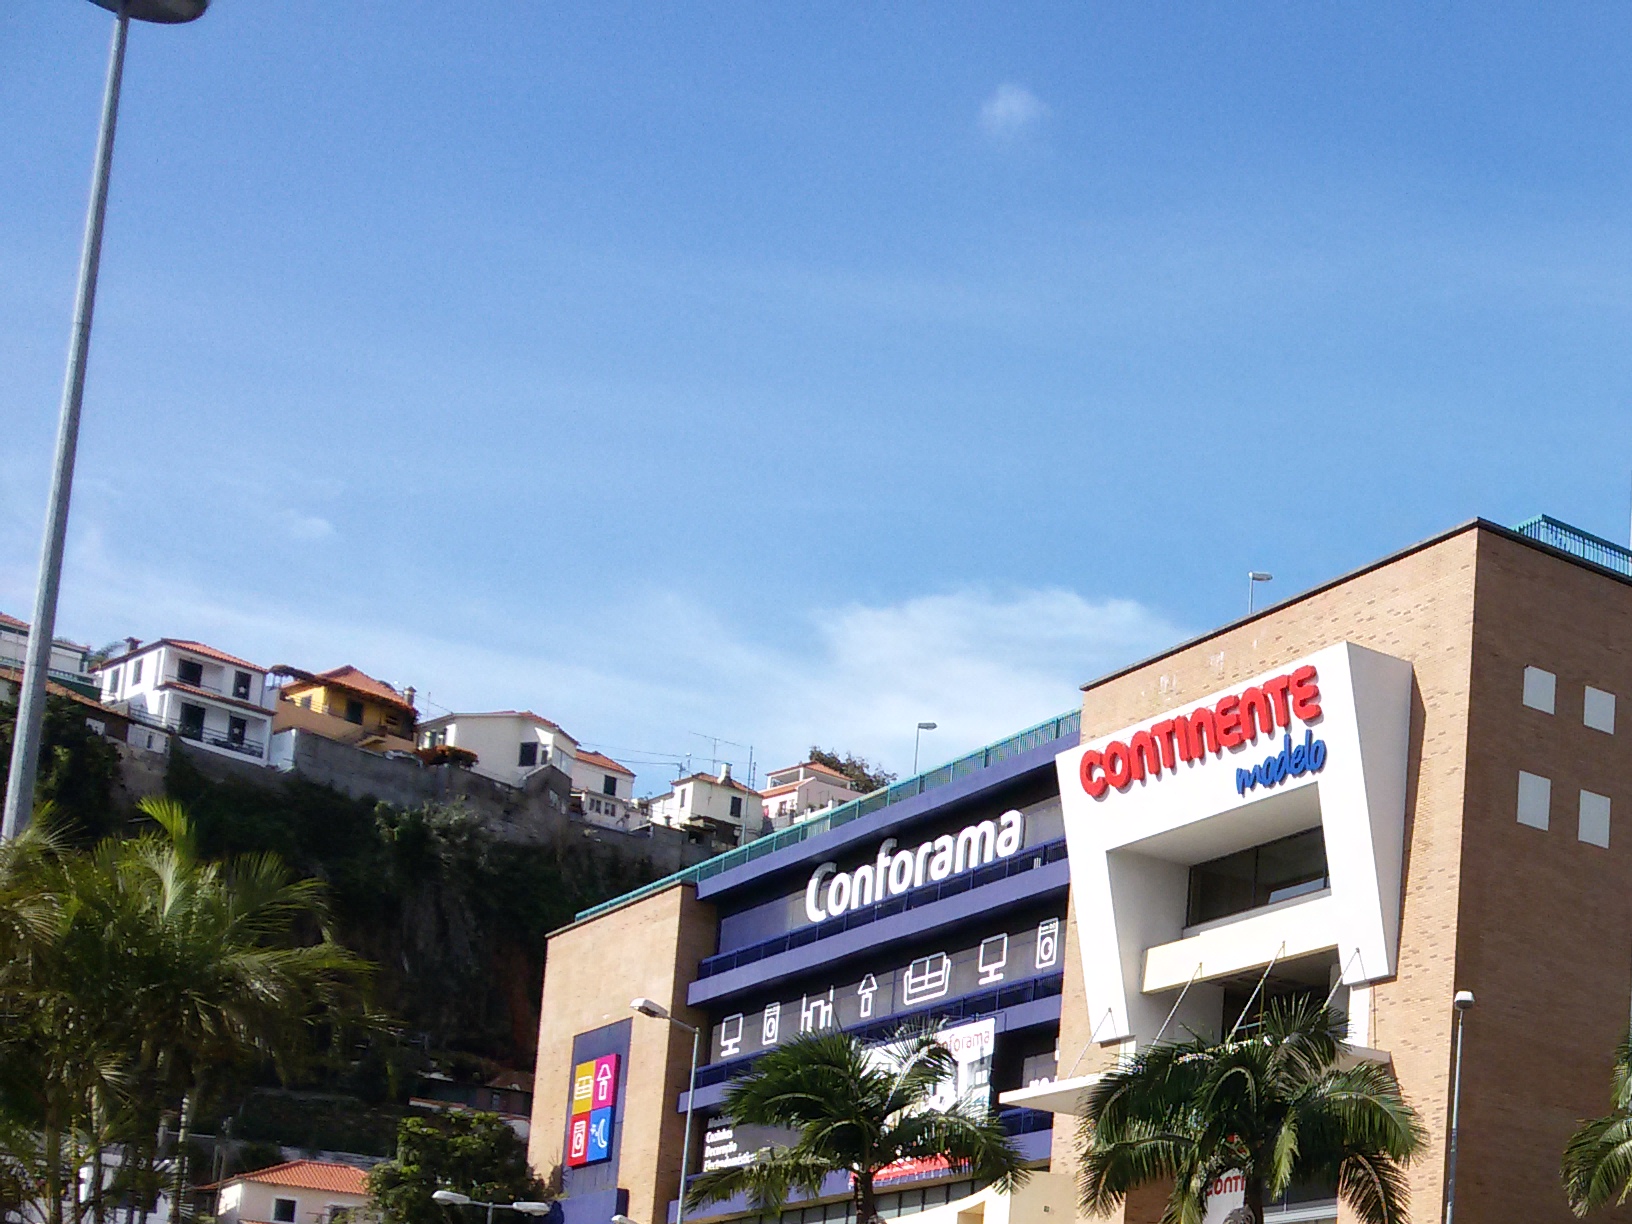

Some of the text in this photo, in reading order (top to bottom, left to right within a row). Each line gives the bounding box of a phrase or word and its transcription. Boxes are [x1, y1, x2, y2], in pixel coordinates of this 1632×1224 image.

[1080, 665, 1322, 798] CONTINENTE
[1236, 729, 1326, 795] modelo
[805, 809, 1025, 923] Conforama
[935, 1030, 990, 1052] onforama
